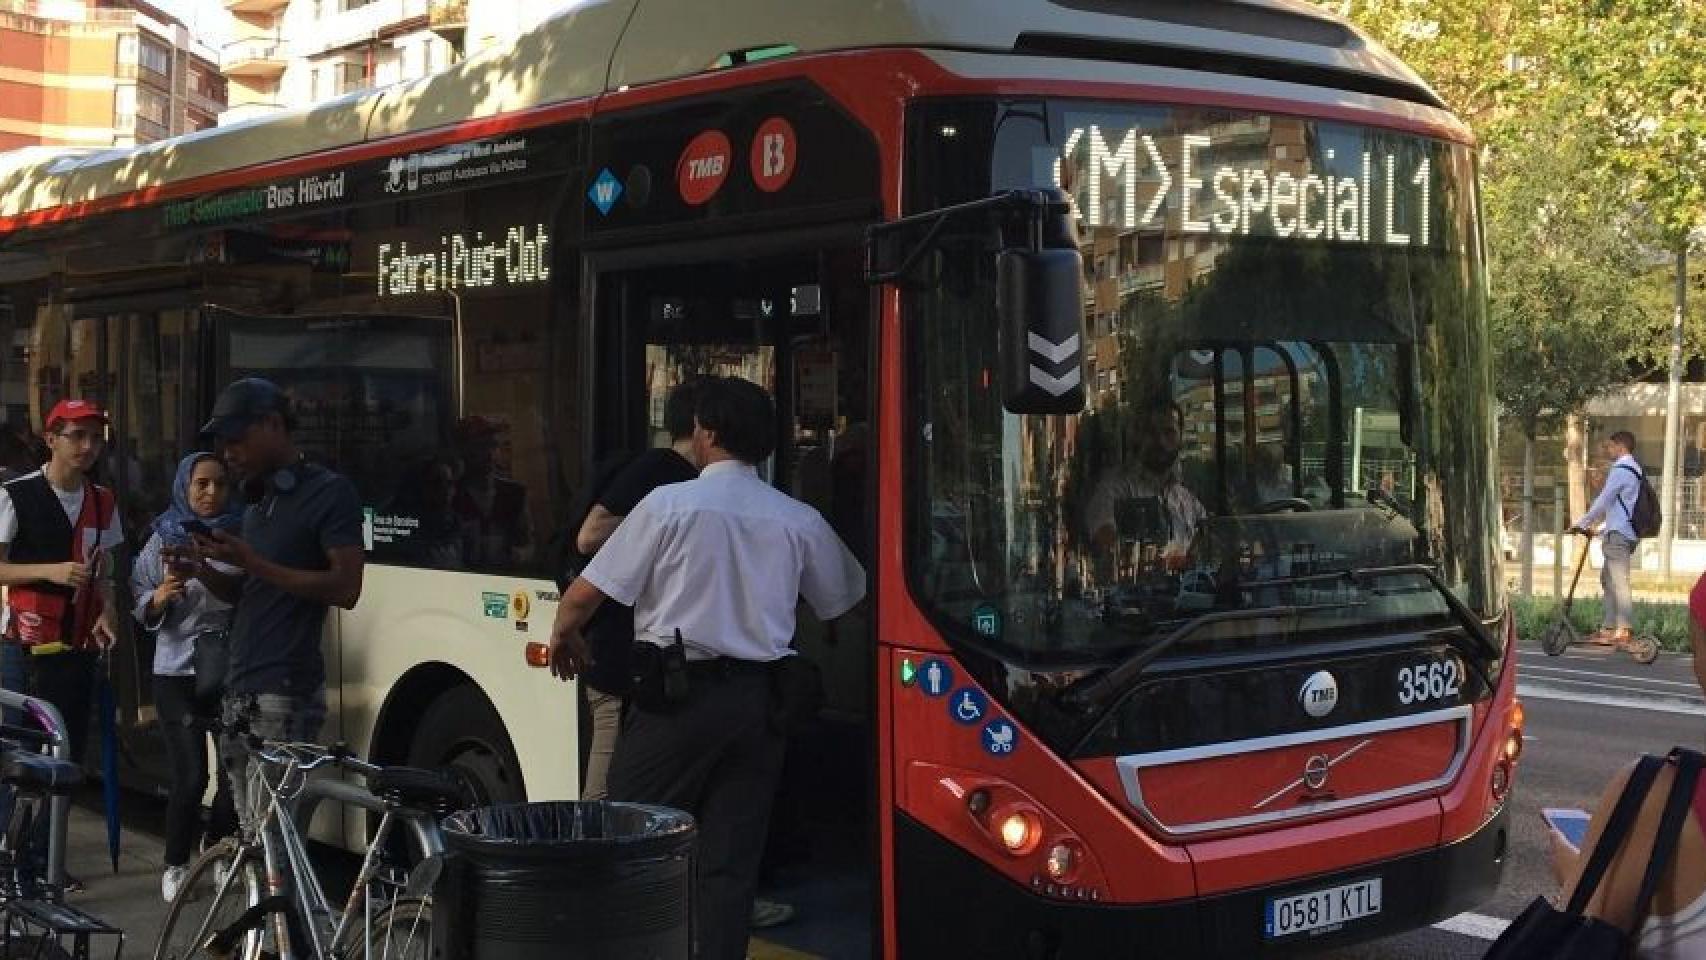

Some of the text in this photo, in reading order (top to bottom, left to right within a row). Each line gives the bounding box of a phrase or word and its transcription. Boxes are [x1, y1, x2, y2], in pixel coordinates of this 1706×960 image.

[689, 155, 725, 181] TMB
[267, 185, 295, 209] Bus
[378, 241, 436, 296] Fabra
[1399, 659, 1459, 705] 3562
[1280, 883, 1378, 931] 0581 KTL
